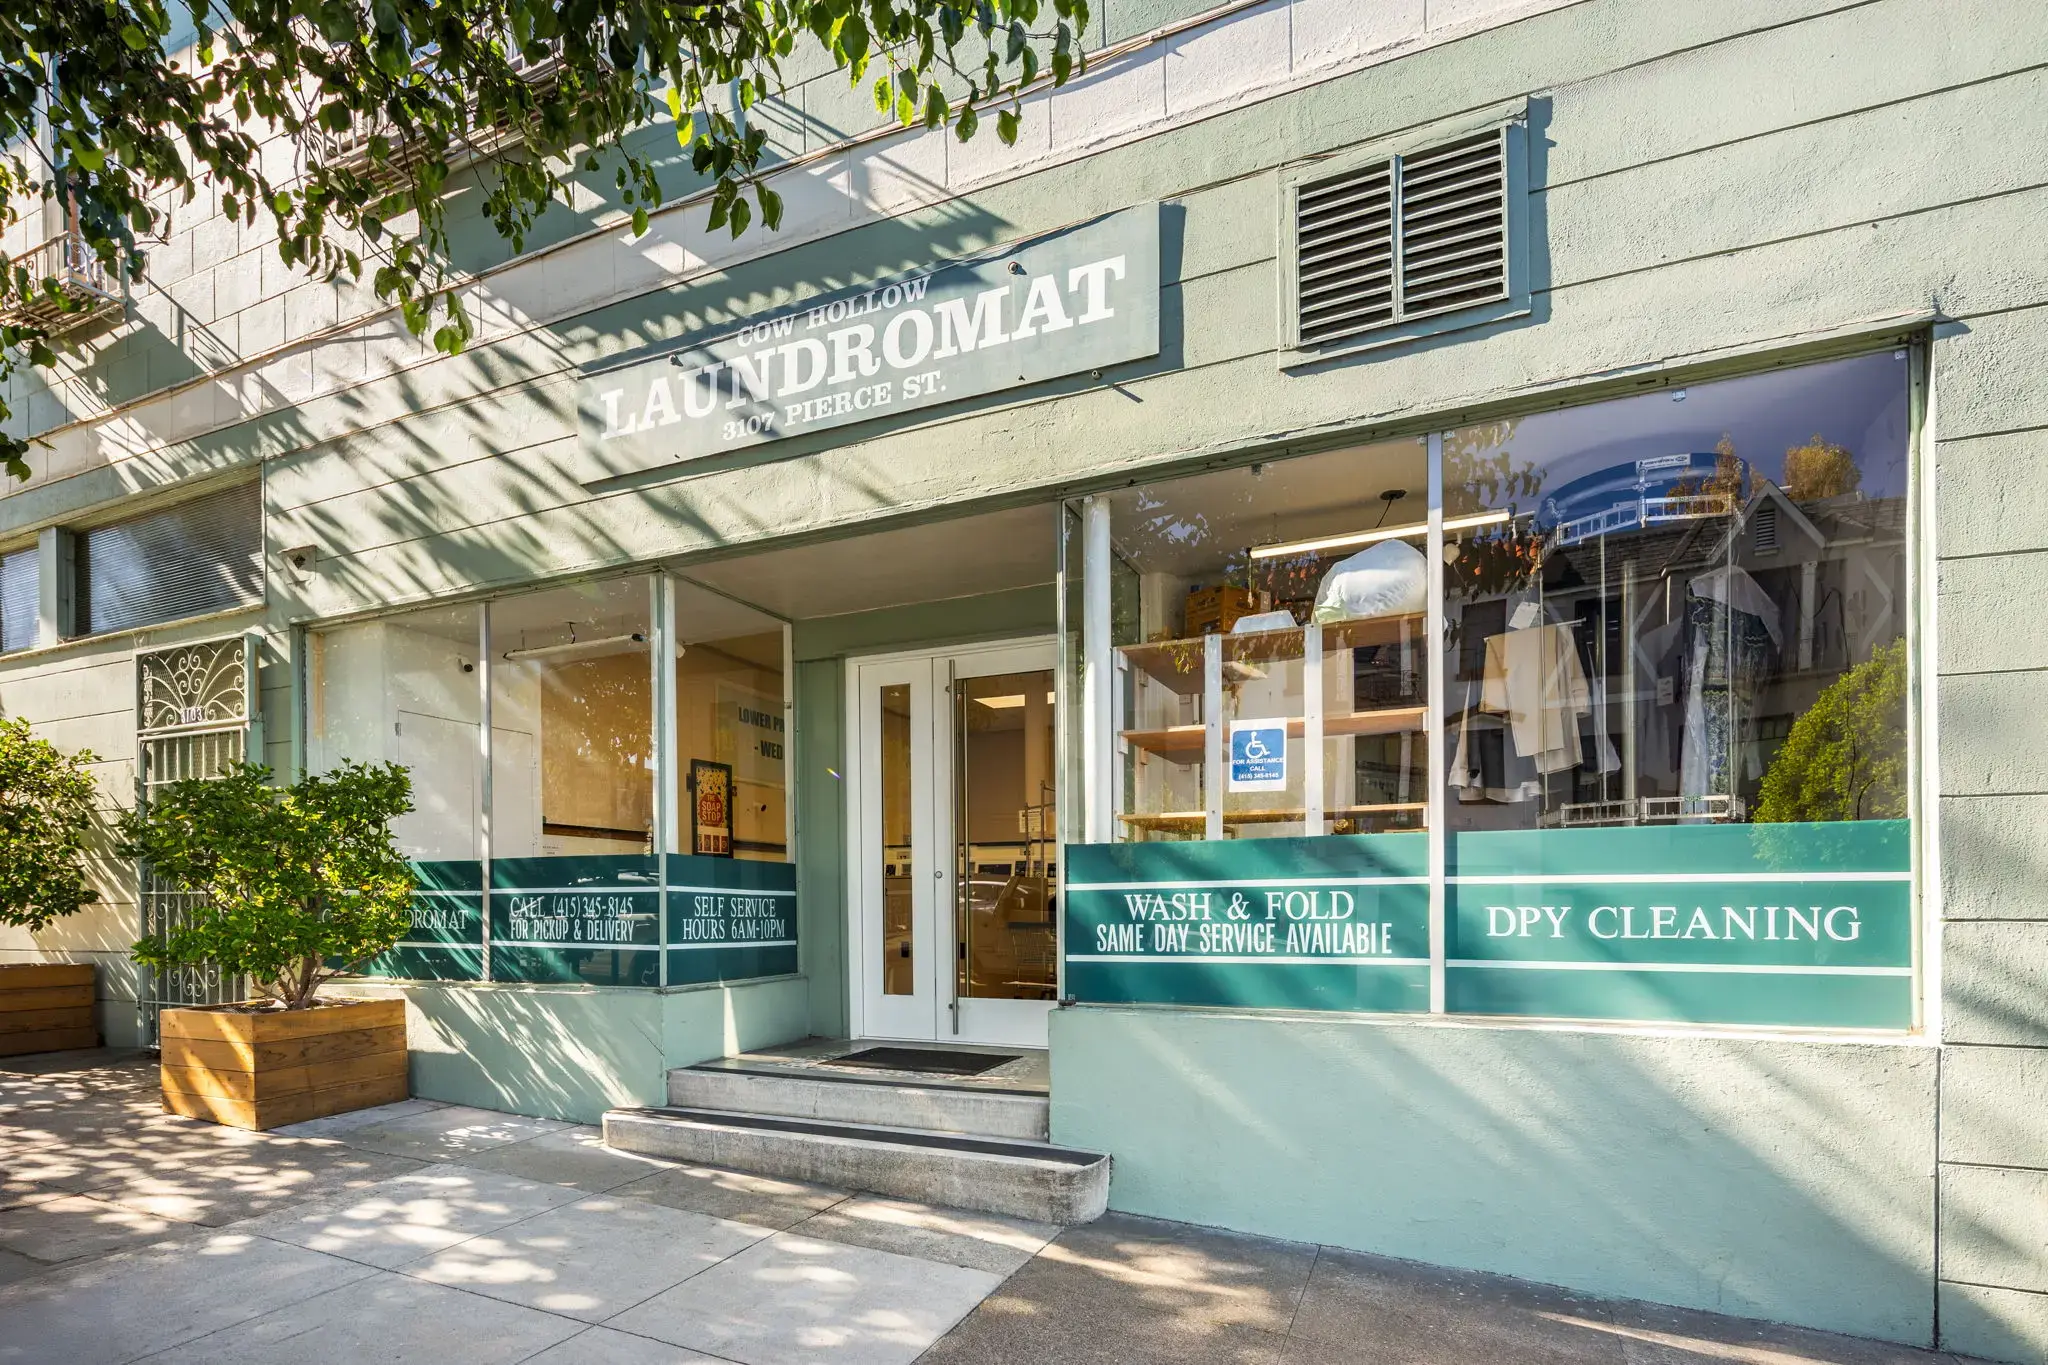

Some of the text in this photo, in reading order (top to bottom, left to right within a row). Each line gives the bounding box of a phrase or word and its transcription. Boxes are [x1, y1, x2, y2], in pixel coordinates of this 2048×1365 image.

[737, 276, 932, 347] COW HOLLOW
[600, 254, 1126, 441] LAUNDROMAT
[722, 370, 947, 441] 3107 PIERCE ST.
[738, 706, 771, 730] LOWER
[701, 801, 721, 811] SOAP
[702, 811, 721, 821] STOP
[510, 896, 545, 917] CALL
[694, 896, 776, 917] SELF SERVICE
[1124, 890, 1354, 921] WASH & FOLD
[510, 919, 634, 941] FOR PICKUP & DELIVERY
[683, 919, 785, 940] HOURS 6AM-10PM
[1588, 906, 1862, 941] CLEANING
[1096, 923, 1144, 952] SAME
[1154, 923, 1189, 953] DAY
[1200, 922, 1275, 953] SERVICE
